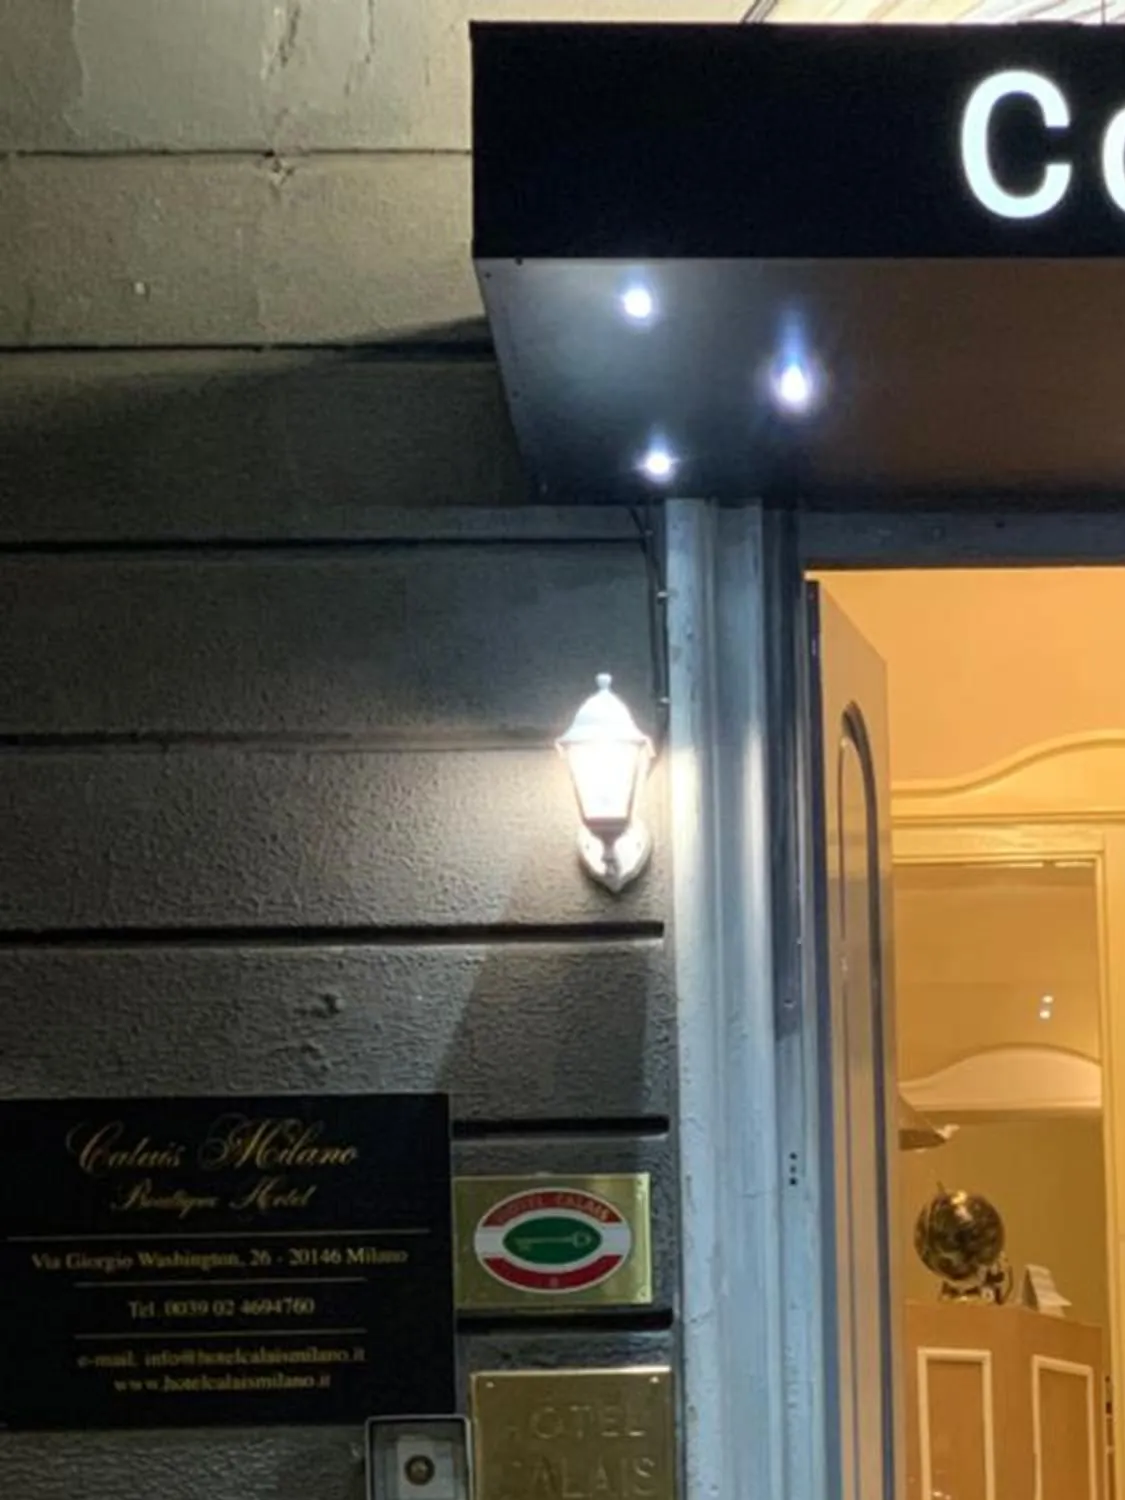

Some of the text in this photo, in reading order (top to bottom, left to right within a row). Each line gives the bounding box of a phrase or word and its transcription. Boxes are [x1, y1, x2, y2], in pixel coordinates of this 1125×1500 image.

[65, 1112, 360, 1178] Calais Milano
[31, 1252, 62, 1271] Via
[65, 1249, 134, 1275] Giorgio
[248, 1248, 272, 1267] 26
[287, 1247, 343, 1267] 20146
[345, 1246, 410, 1265] Milano
